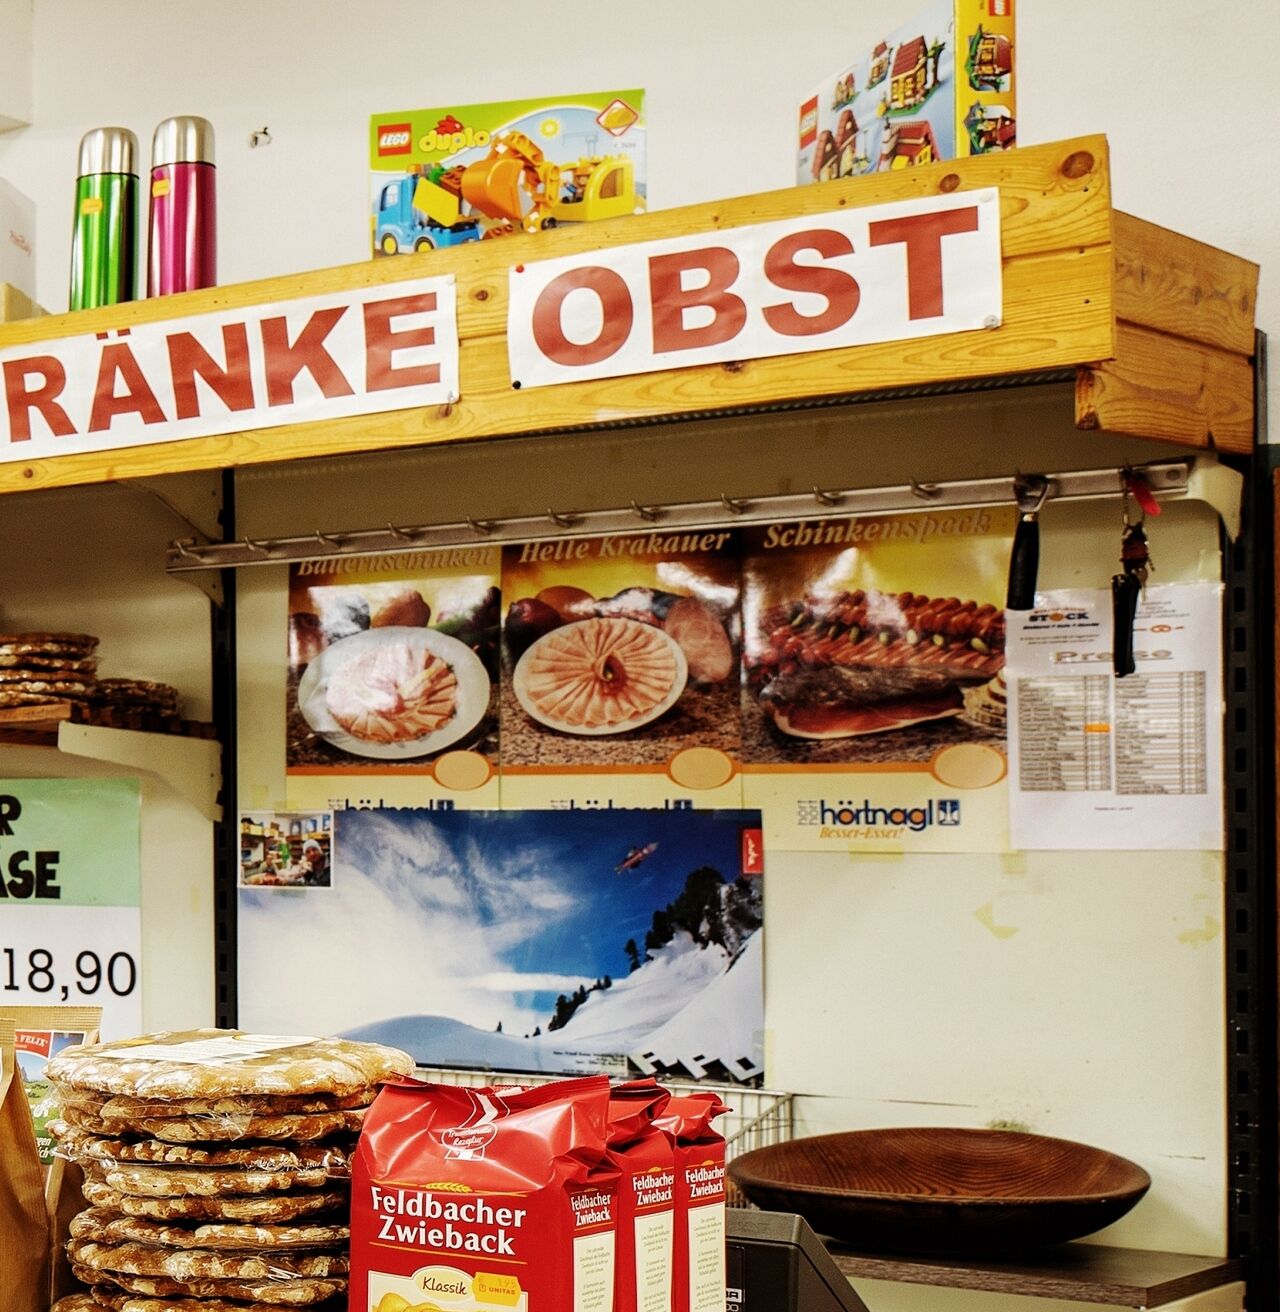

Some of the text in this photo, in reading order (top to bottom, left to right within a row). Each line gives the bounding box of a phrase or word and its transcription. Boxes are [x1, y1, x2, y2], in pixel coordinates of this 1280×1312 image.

[379, 132, 411, 151] LEGO
[419, 127, 490, 154] duplo
[532, 206, 979, 367] OBST
[520, 530, 730, 563] Helle Krakauer
[820, 800, 933, 832] hörtnagl
[3, 947, 138, 1002] 18,90
[632, 1171, 674, 1191] Feldbacher
[685, 1165, 725, 1184] Feldbacher
[636, 1187, 674, 1206] Zwieback
[689, 1180, 724, 1199] Zwieback
[370, 1186, 528, 1229] Feldbacher
[570, 1192, 612, 1213] Feldbacher
[575, 1207, 612, 1227] Zwieback
[378, 1214, 516, 1256] Zwieback
[422, 1275, 468, 1296] Klassik
[488, 1286, 516, 1296] UNITAS
